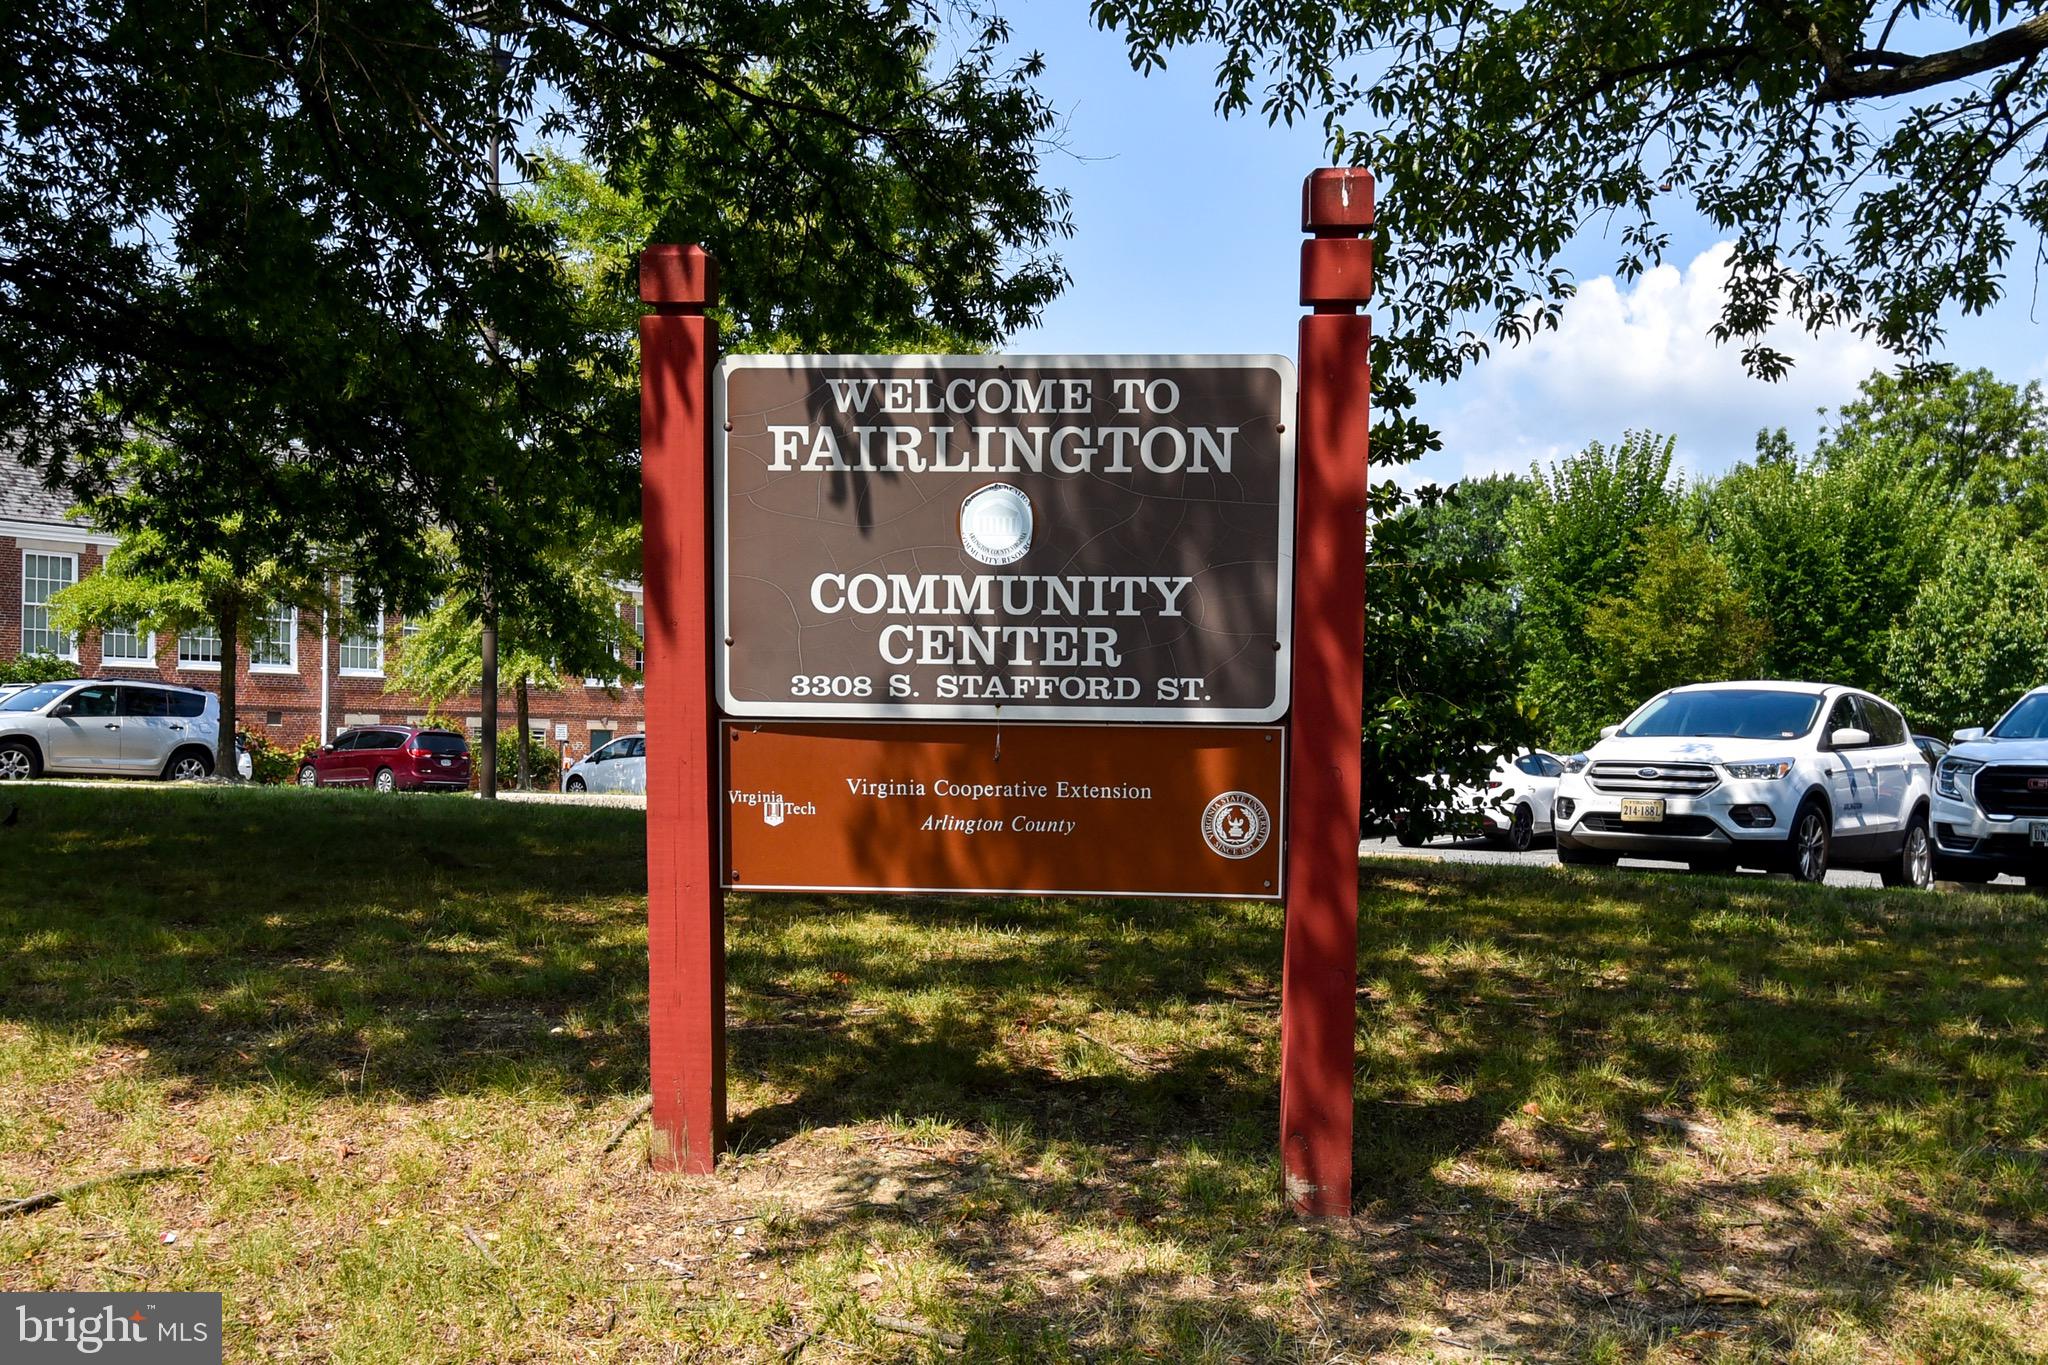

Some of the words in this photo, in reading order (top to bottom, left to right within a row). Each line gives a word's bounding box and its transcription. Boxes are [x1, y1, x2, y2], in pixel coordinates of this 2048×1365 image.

[826, 379, 1092, 414] WELCOME
[1114, 379, 1180, 414] TO
[767, 425, 1239, 474] FAIRLINGTON
[810, 573, 1193, 617] COMMUNITY
[878, 624, 1122, 668] CENTER
[791, 676, 872, 697] 3308
[888, 675, 920, 699] S.
[936, 676, 1141, 701] STAFFORD
[1157, 679, 1212, 702] ST.
[728, 790, 784, 807] Virginia
[847, 778, 926, 798] Virginia
[934, 779, 1048, 800] Cooperative
[1056, 781, 1153, 799] Extension
[784, 801, 816, 815] Tech
[1205, 803, 1221, 839] VIRGINIA
[1221, 795, 1246, 805] STATE
[1623, 805, 1661, 817] 214-188L
[920, 814, 1004, 834] Arlington
[1011, 815, 1076, 835] County
